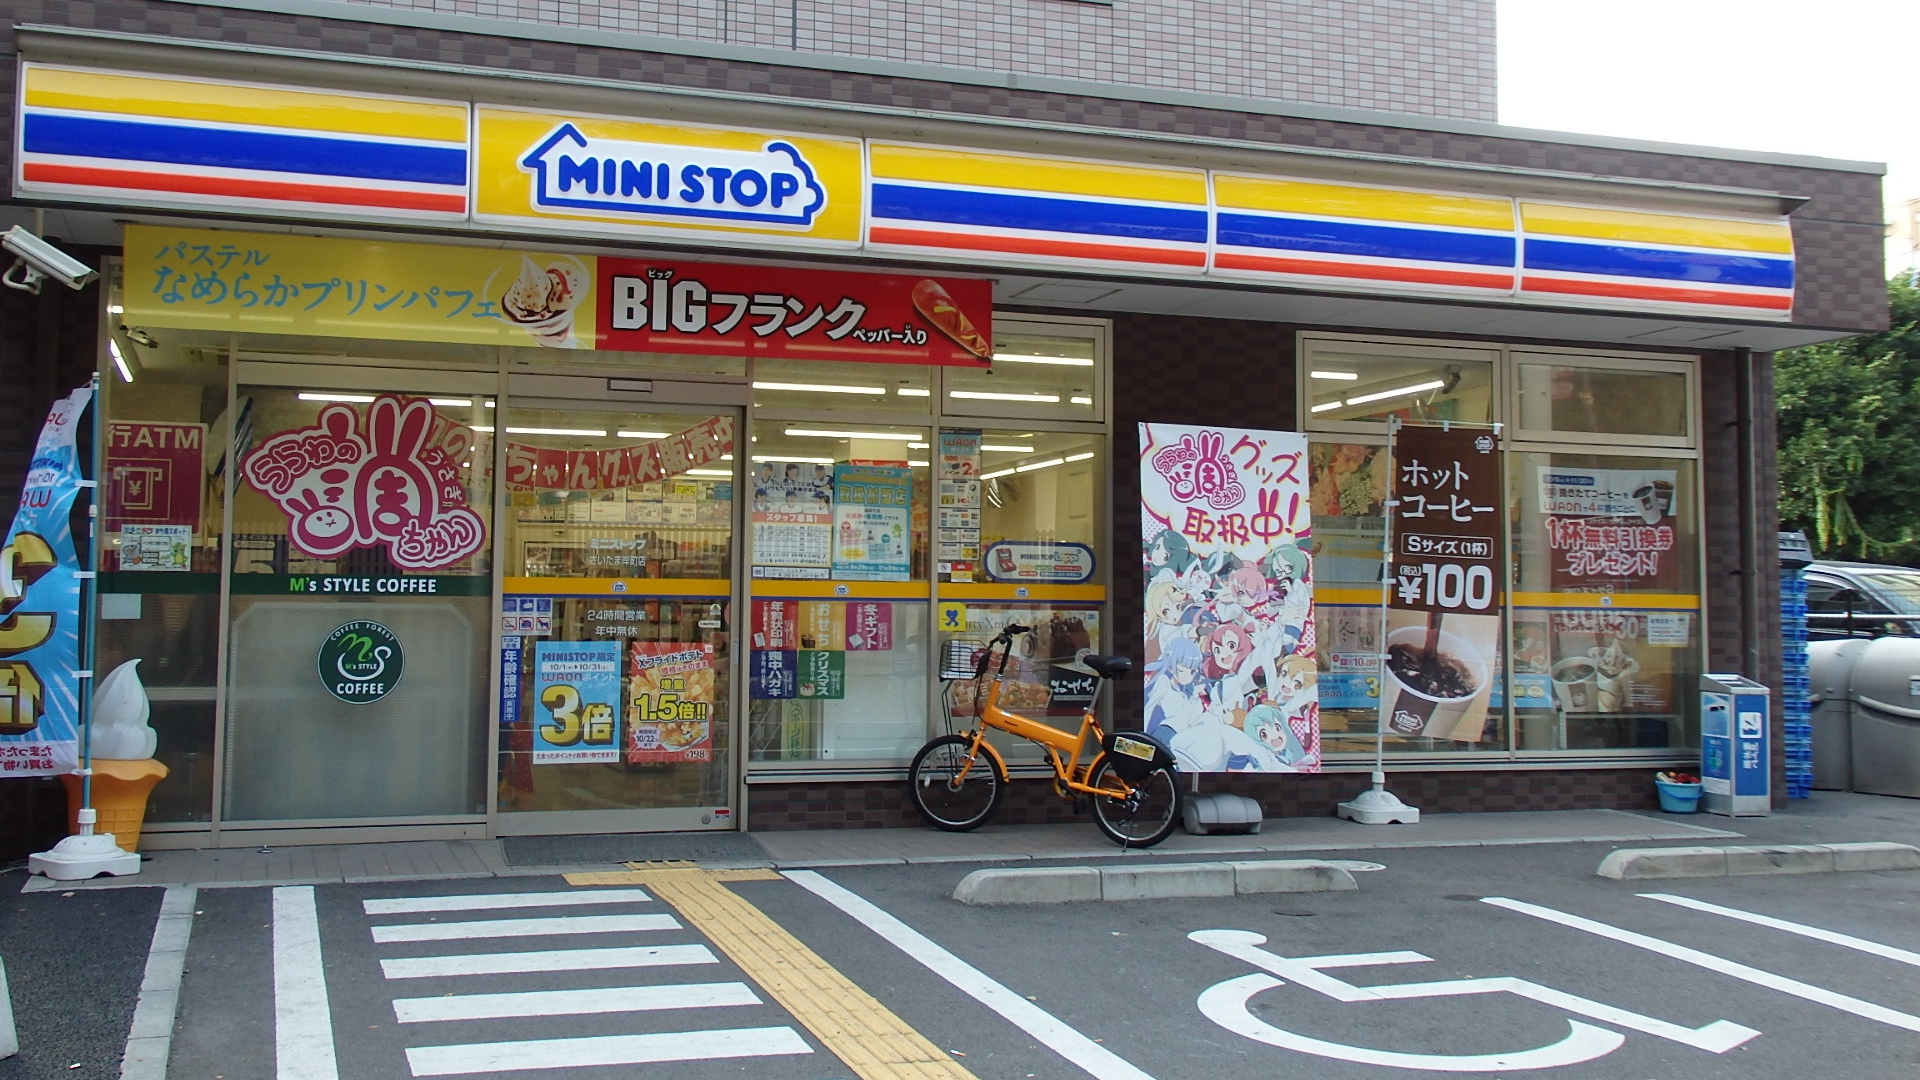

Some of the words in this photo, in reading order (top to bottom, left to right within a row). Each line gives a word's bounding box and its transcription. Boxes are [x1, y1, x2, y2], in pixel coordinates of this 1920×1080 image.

[558, 154, 670, 200] MINI
[679, 164, 799, 208] STOP
[155, 240, 271, 267] パステル
[648, 269, 673, 279] ビッグ
[153, 265, 503, 319] なめらかプリンパフェ
[853, 328, 927, 345] ペッパー入り
[427, 450, 463, 501] うさぎ
[1230, 434, 1302, 484] グッズ
[1401, 458, 1470, 491] ホット
[251, 438, 362, 493] うらわの
[400, 518, 473, 560] ちゃん
[1401, 493, 1495, 523] コーヒー
[590, 539, 647, 550] ミニストップ
[1545, 516, 1673, 551] 1杯無料引換券
[589, 555, 646, 567] さいたま岸町店
[323, 578, 370, 592] STYLE
[376, 579, 437, 593] COFFEE
[1397, 563, 1493, 610] ¥100
[331, 623, 360, 641] COFFEE
[366, 623, 395, 642] FOREST
[587, 609, 647, 621] 24時間営業
[595, 625, 638, 637] 年中無休
[770, 601, 784, 648] 年賀状印刷
[817, 603, 831, 646] おせち
[863, 604, 879, 649] 冬ギフト
[336, 682, 384, 695] COFFEE
[503, 650, 517, 699] 年齢確認
[768, 651, 783, 697] 喪中ハガキ
[817, 651, 830, 696] クリスマス
[1050, 677, 1095, 694] おせち
[539, 684, 615, 746] 3倍
